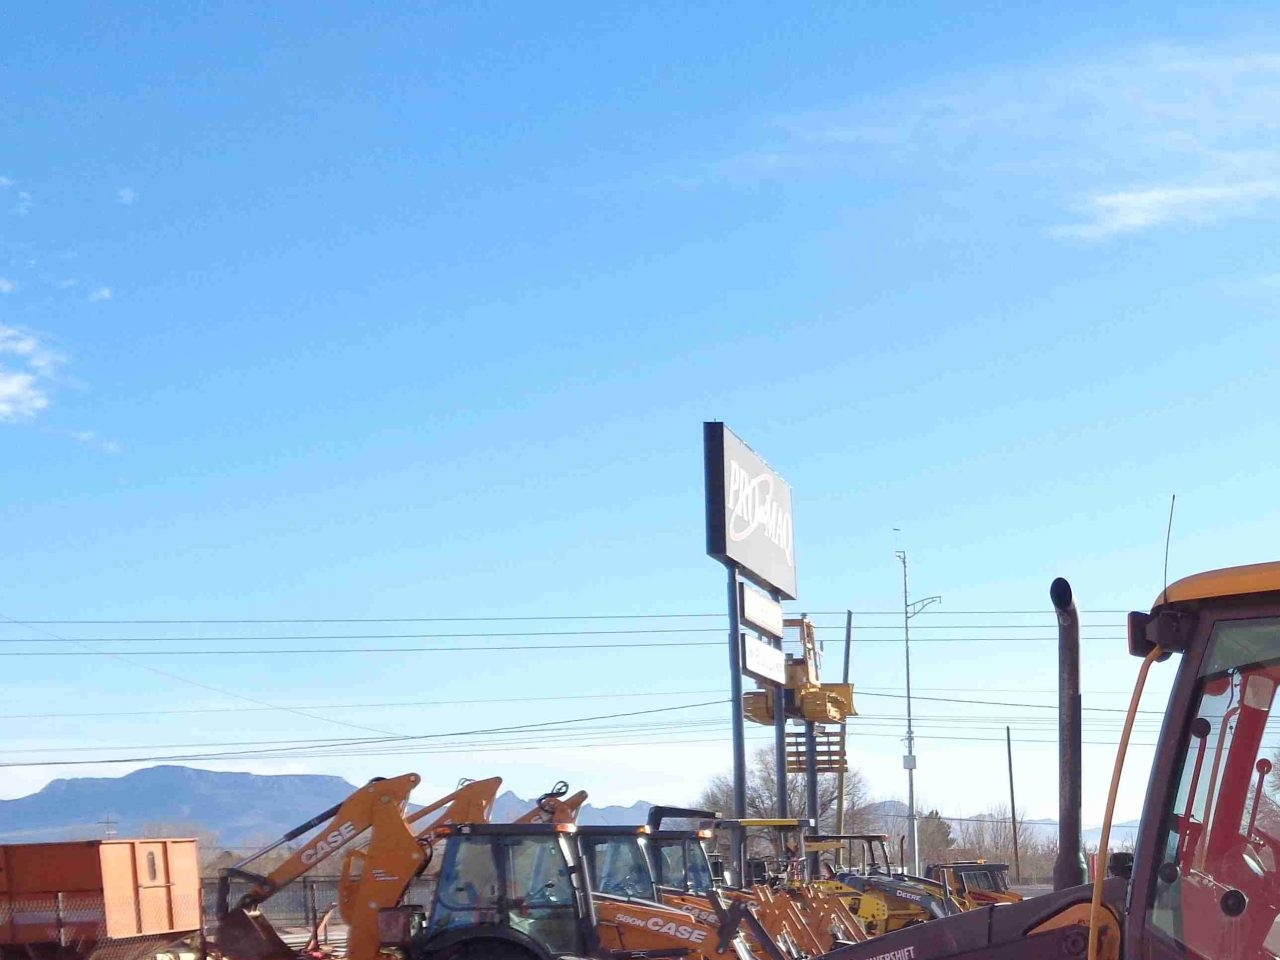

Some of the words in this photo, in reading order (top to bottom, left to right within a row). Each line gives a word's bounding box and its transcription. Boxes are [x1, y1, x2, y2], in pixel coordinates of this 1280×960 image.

[301, 821, 356, 864] CASE
[896, 889, 921, 901] DEERE
[681, 905, 719, 924] CASE
[647, 917, 708, 944] CASE
